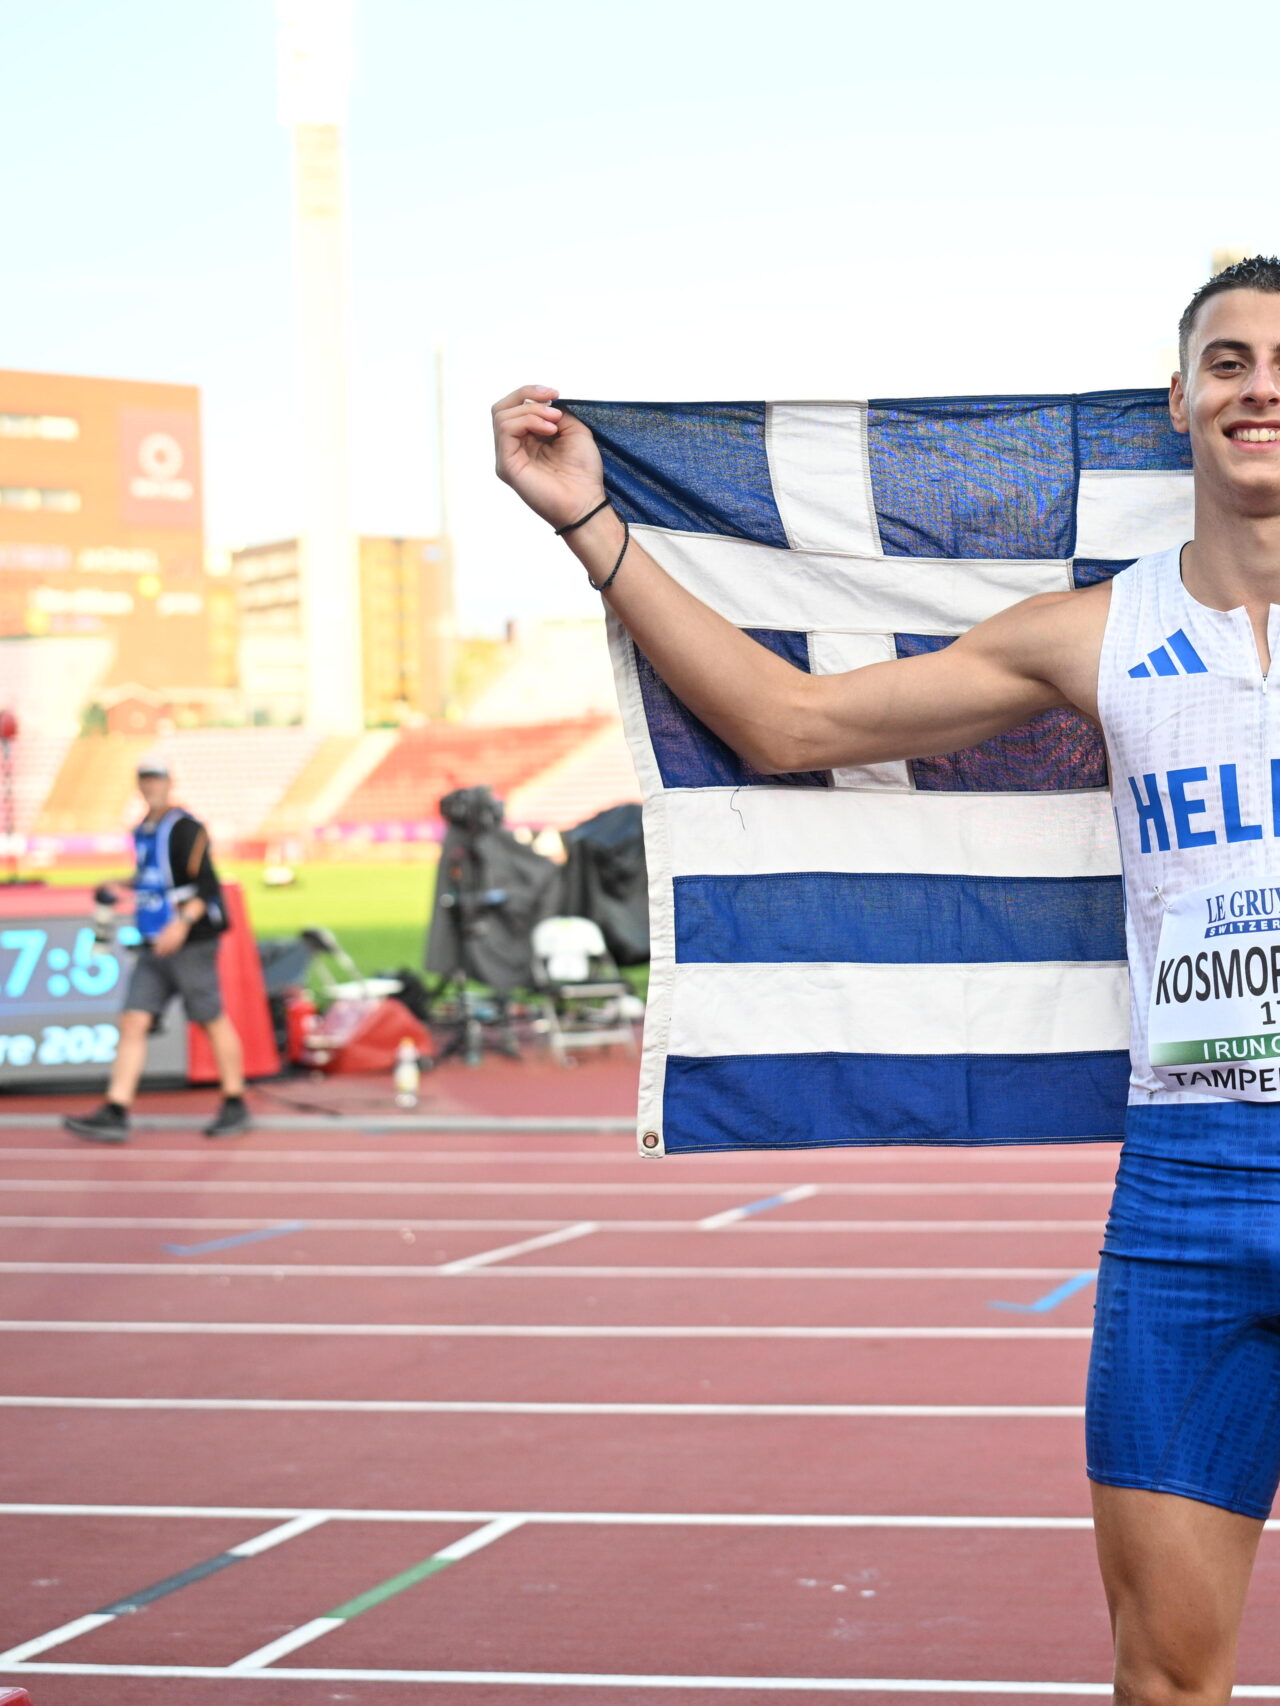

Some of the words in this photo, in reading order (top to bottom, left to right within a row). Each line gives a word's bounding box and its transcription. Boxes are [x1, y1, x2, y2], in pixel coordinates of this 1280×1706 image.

[1206, 894, 1226, 924] LE
[1203, 1042, 1210, 1060] I
[1215, 1037, 1266, 1059] RUN
